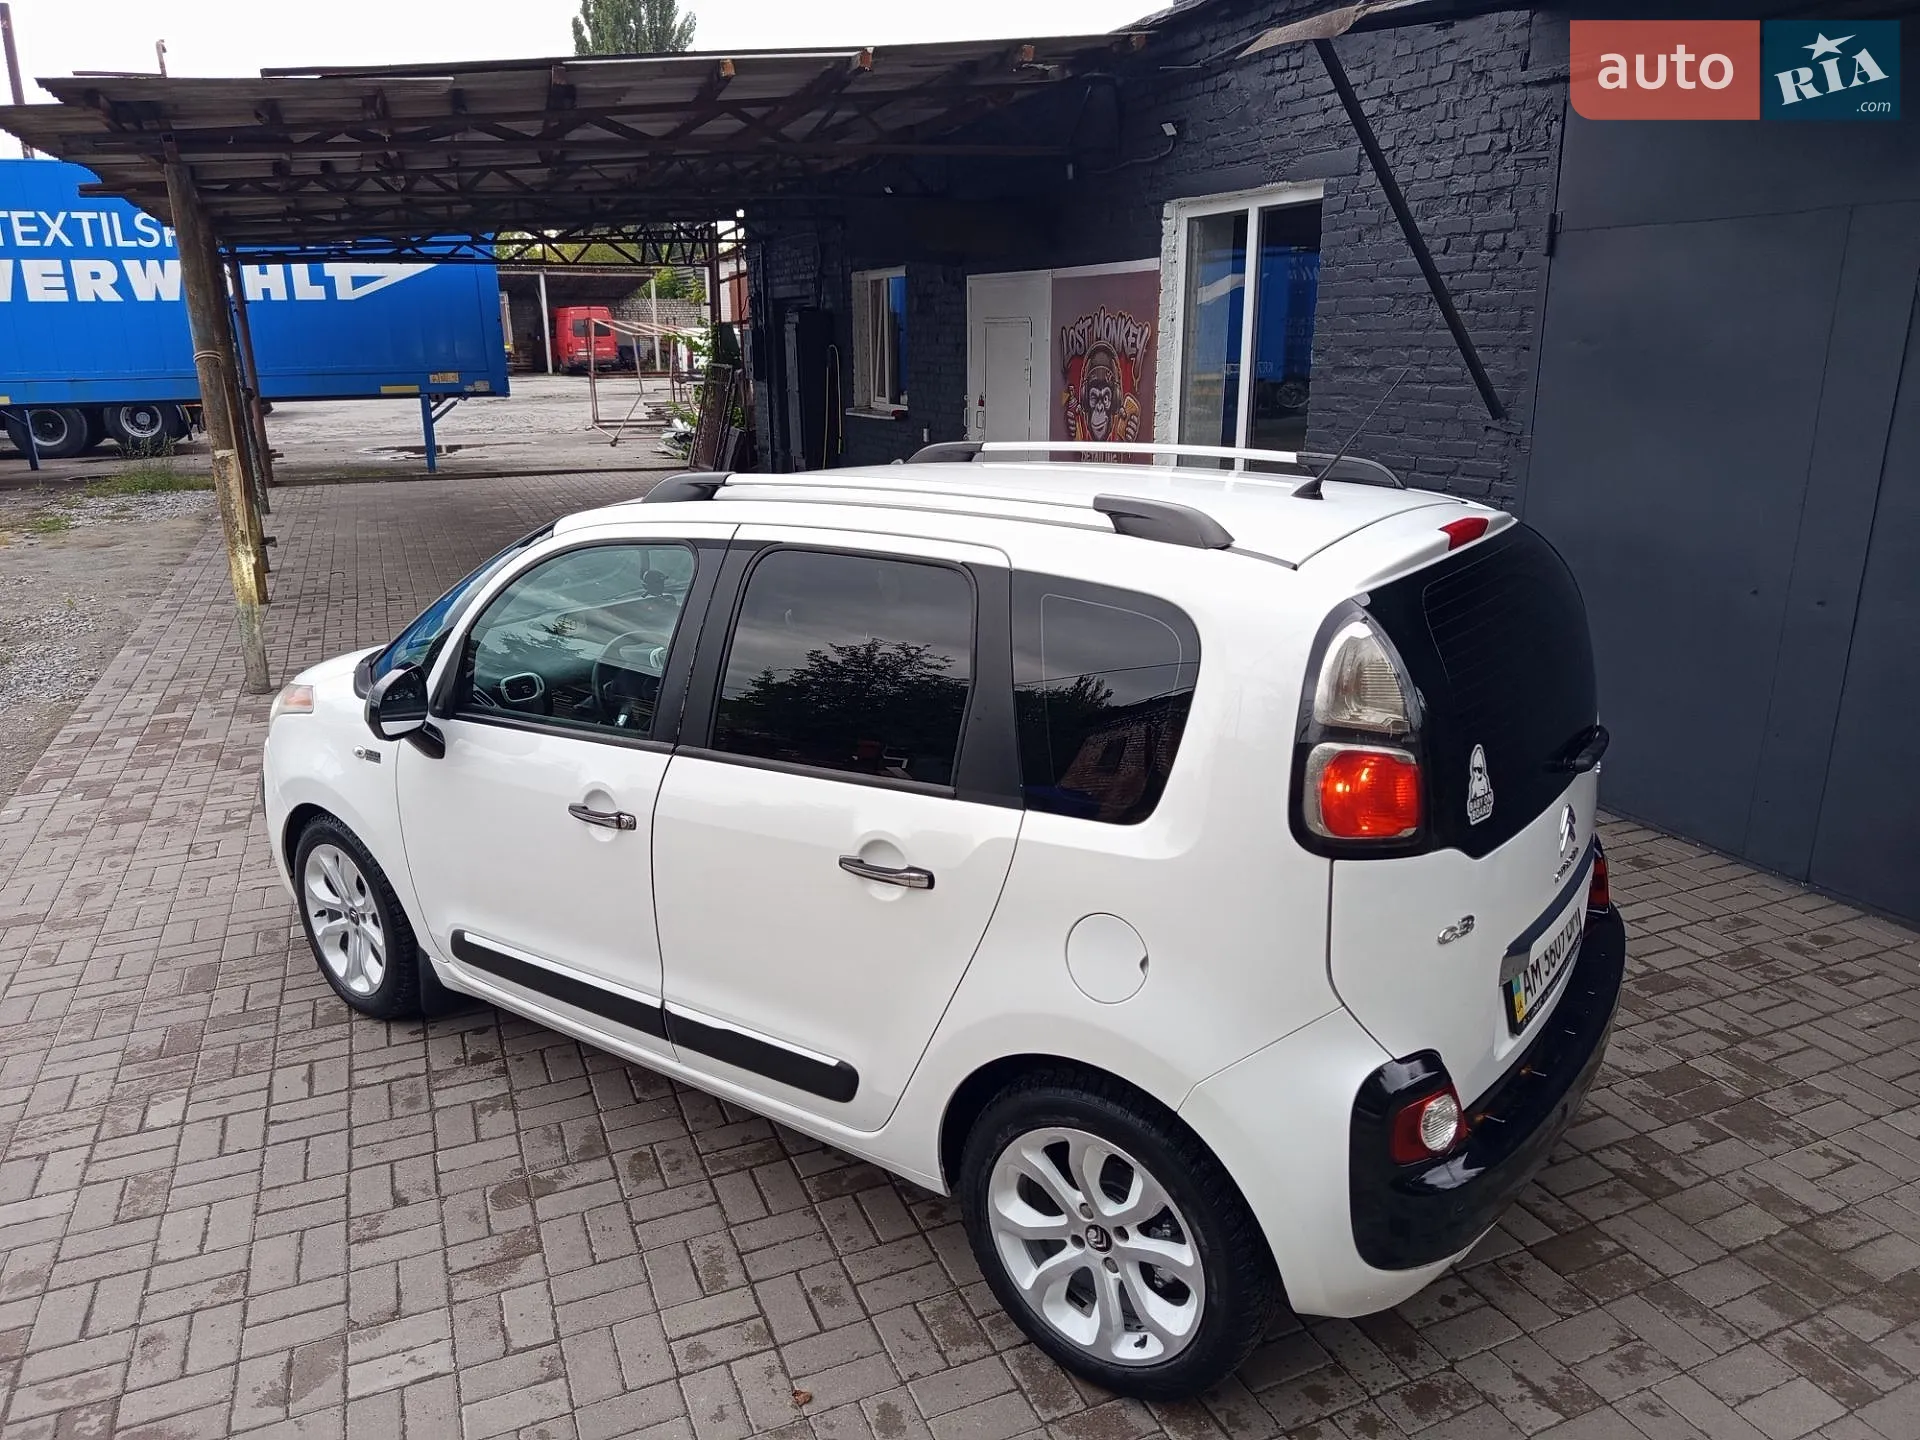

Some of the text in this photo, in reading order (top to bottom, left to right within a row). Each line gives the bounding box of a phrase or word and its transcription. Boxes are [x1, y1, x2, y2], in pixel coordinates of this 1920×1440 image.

[1061, 306, 1150, 376] LOST MONKEY
[1438, 914, 1475, 945] C3
[1523, 958, 1542, 1005] AM
